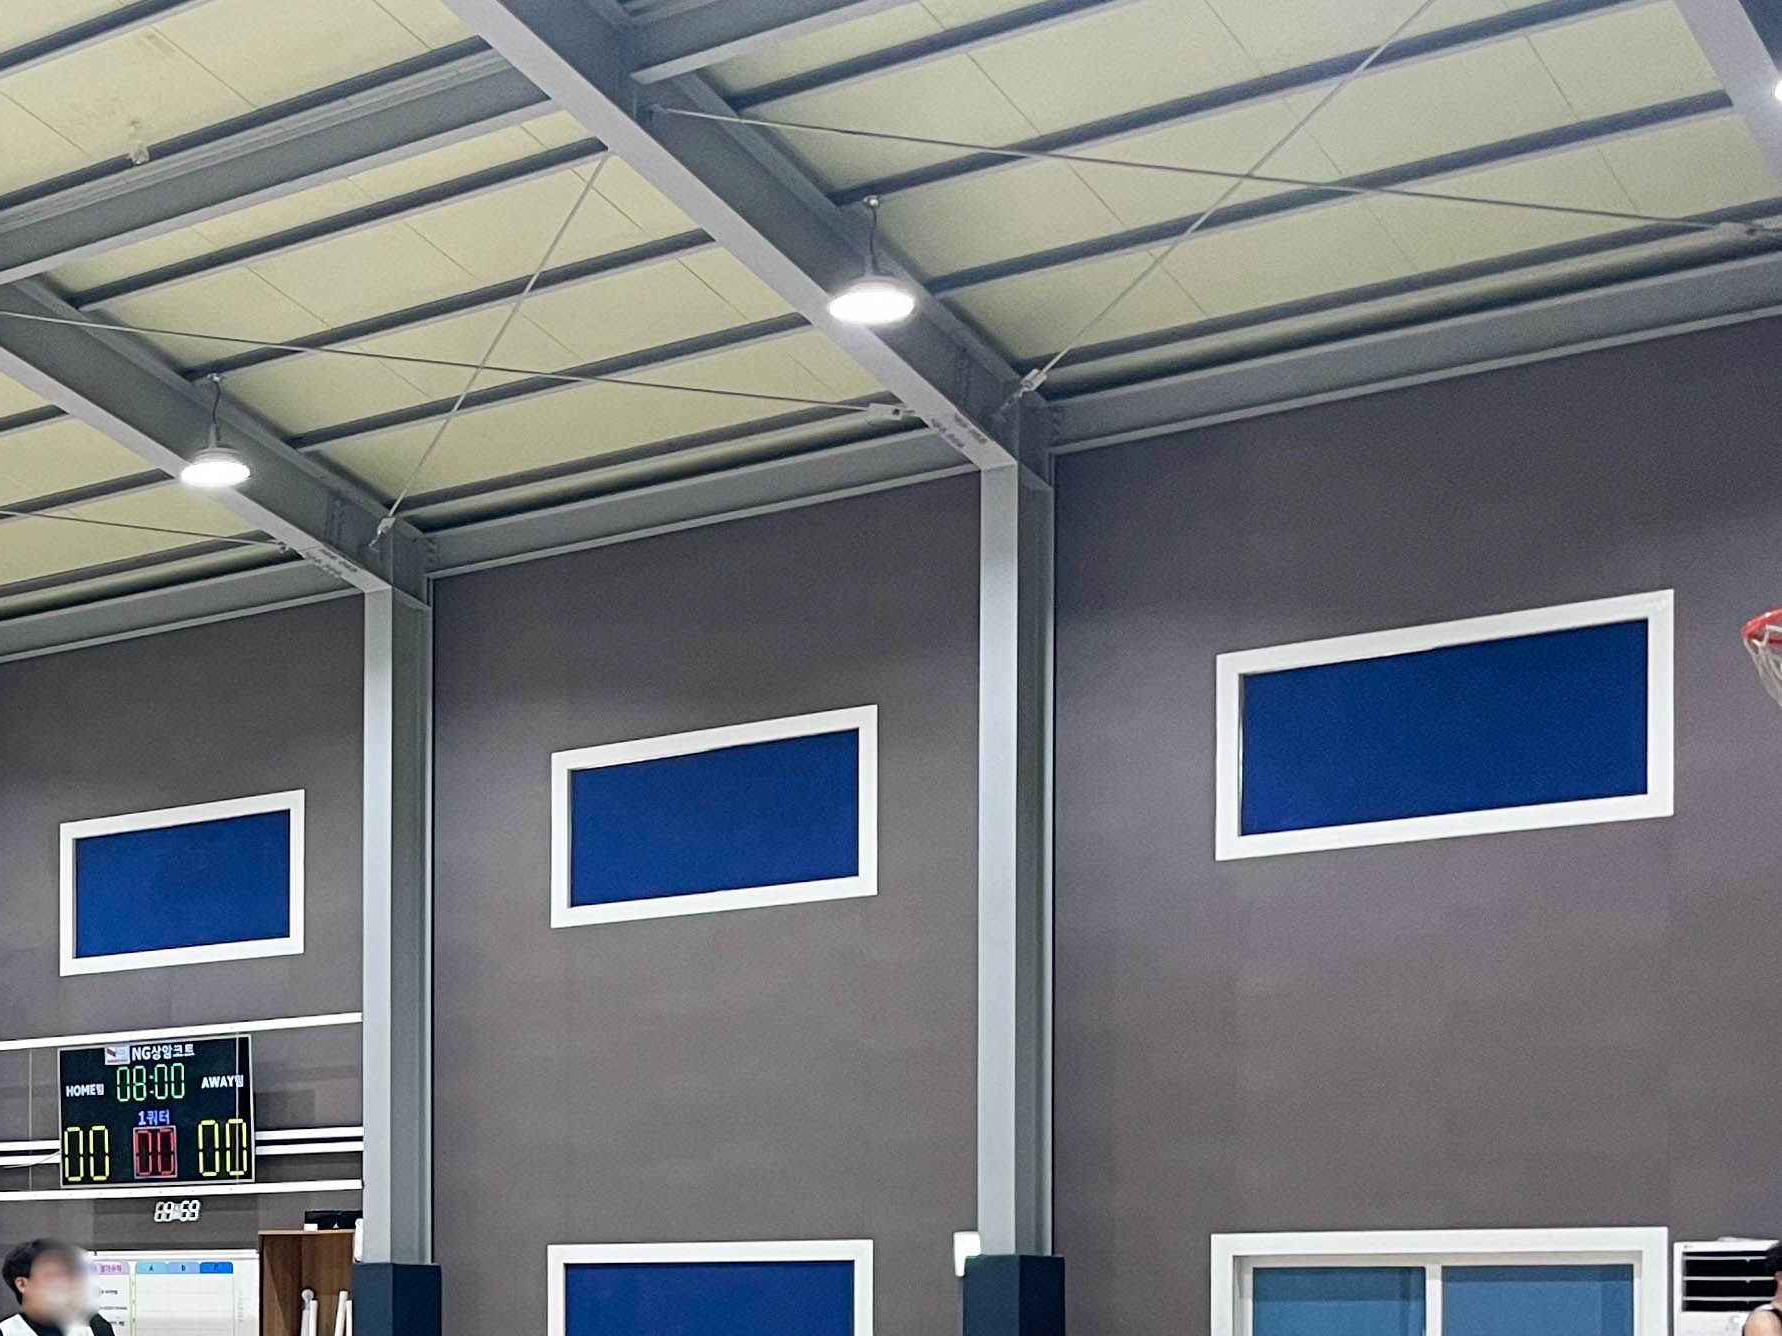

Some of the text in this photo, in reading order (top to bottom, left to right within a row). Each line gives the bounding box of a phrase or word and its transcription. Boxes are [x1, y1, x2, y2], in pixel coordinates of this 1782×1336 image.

[116, 1063, 186, 1103] 08:00
[138, 1109, 171, 1125] 1쿼터
[64, 1125, 110, 1182] 00
[197, 1118, 248, 1177] 00
